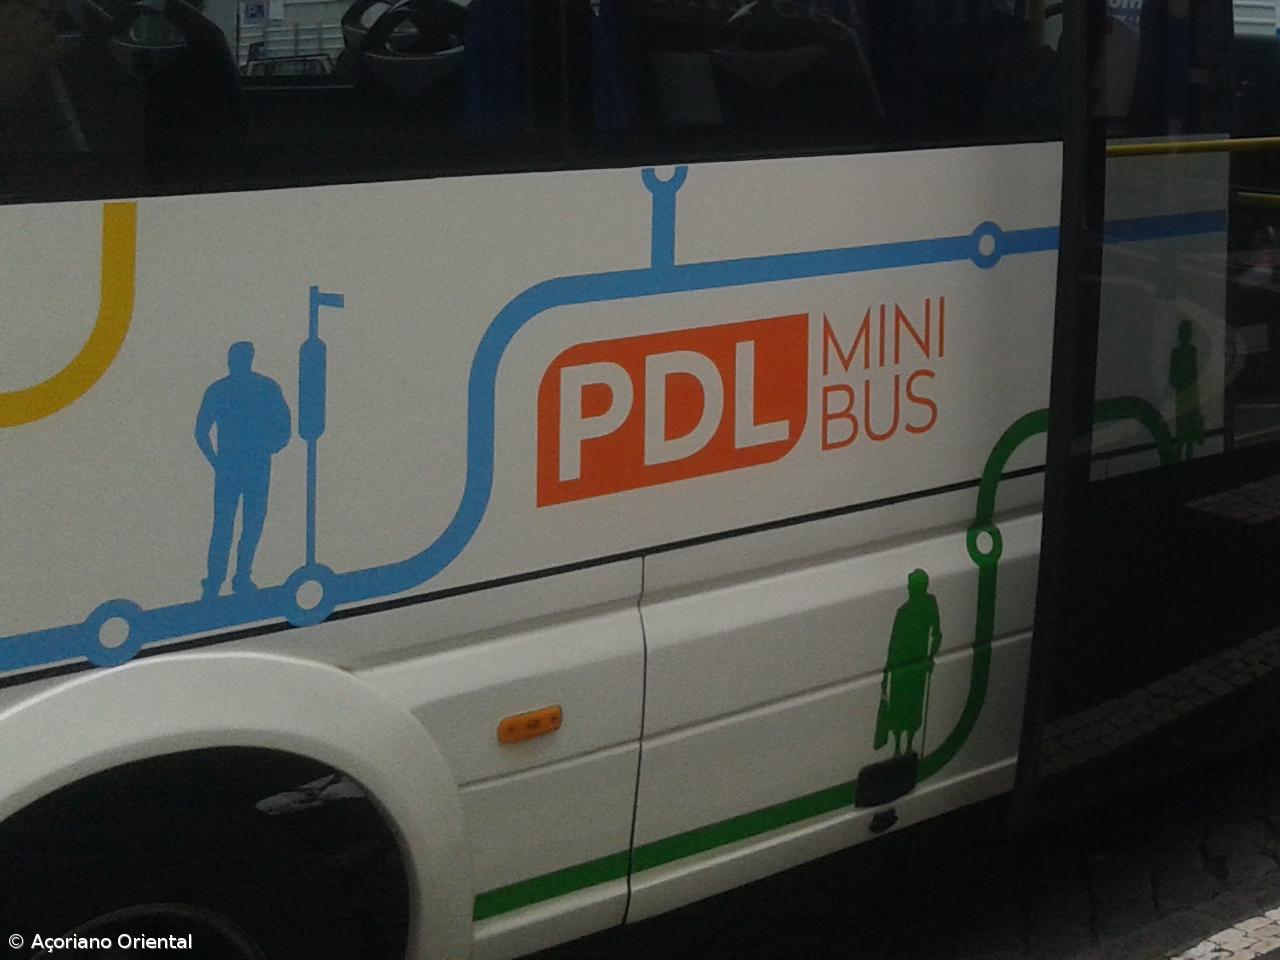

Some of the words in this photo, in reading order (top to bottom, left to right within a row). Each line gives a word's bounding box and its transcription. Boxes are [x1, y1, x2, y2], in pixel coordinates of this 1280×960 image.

[823, 296, 945, 377] MINI
[558, 340, 790, 483] PDL
[821, 368, 938, 452] BUS
